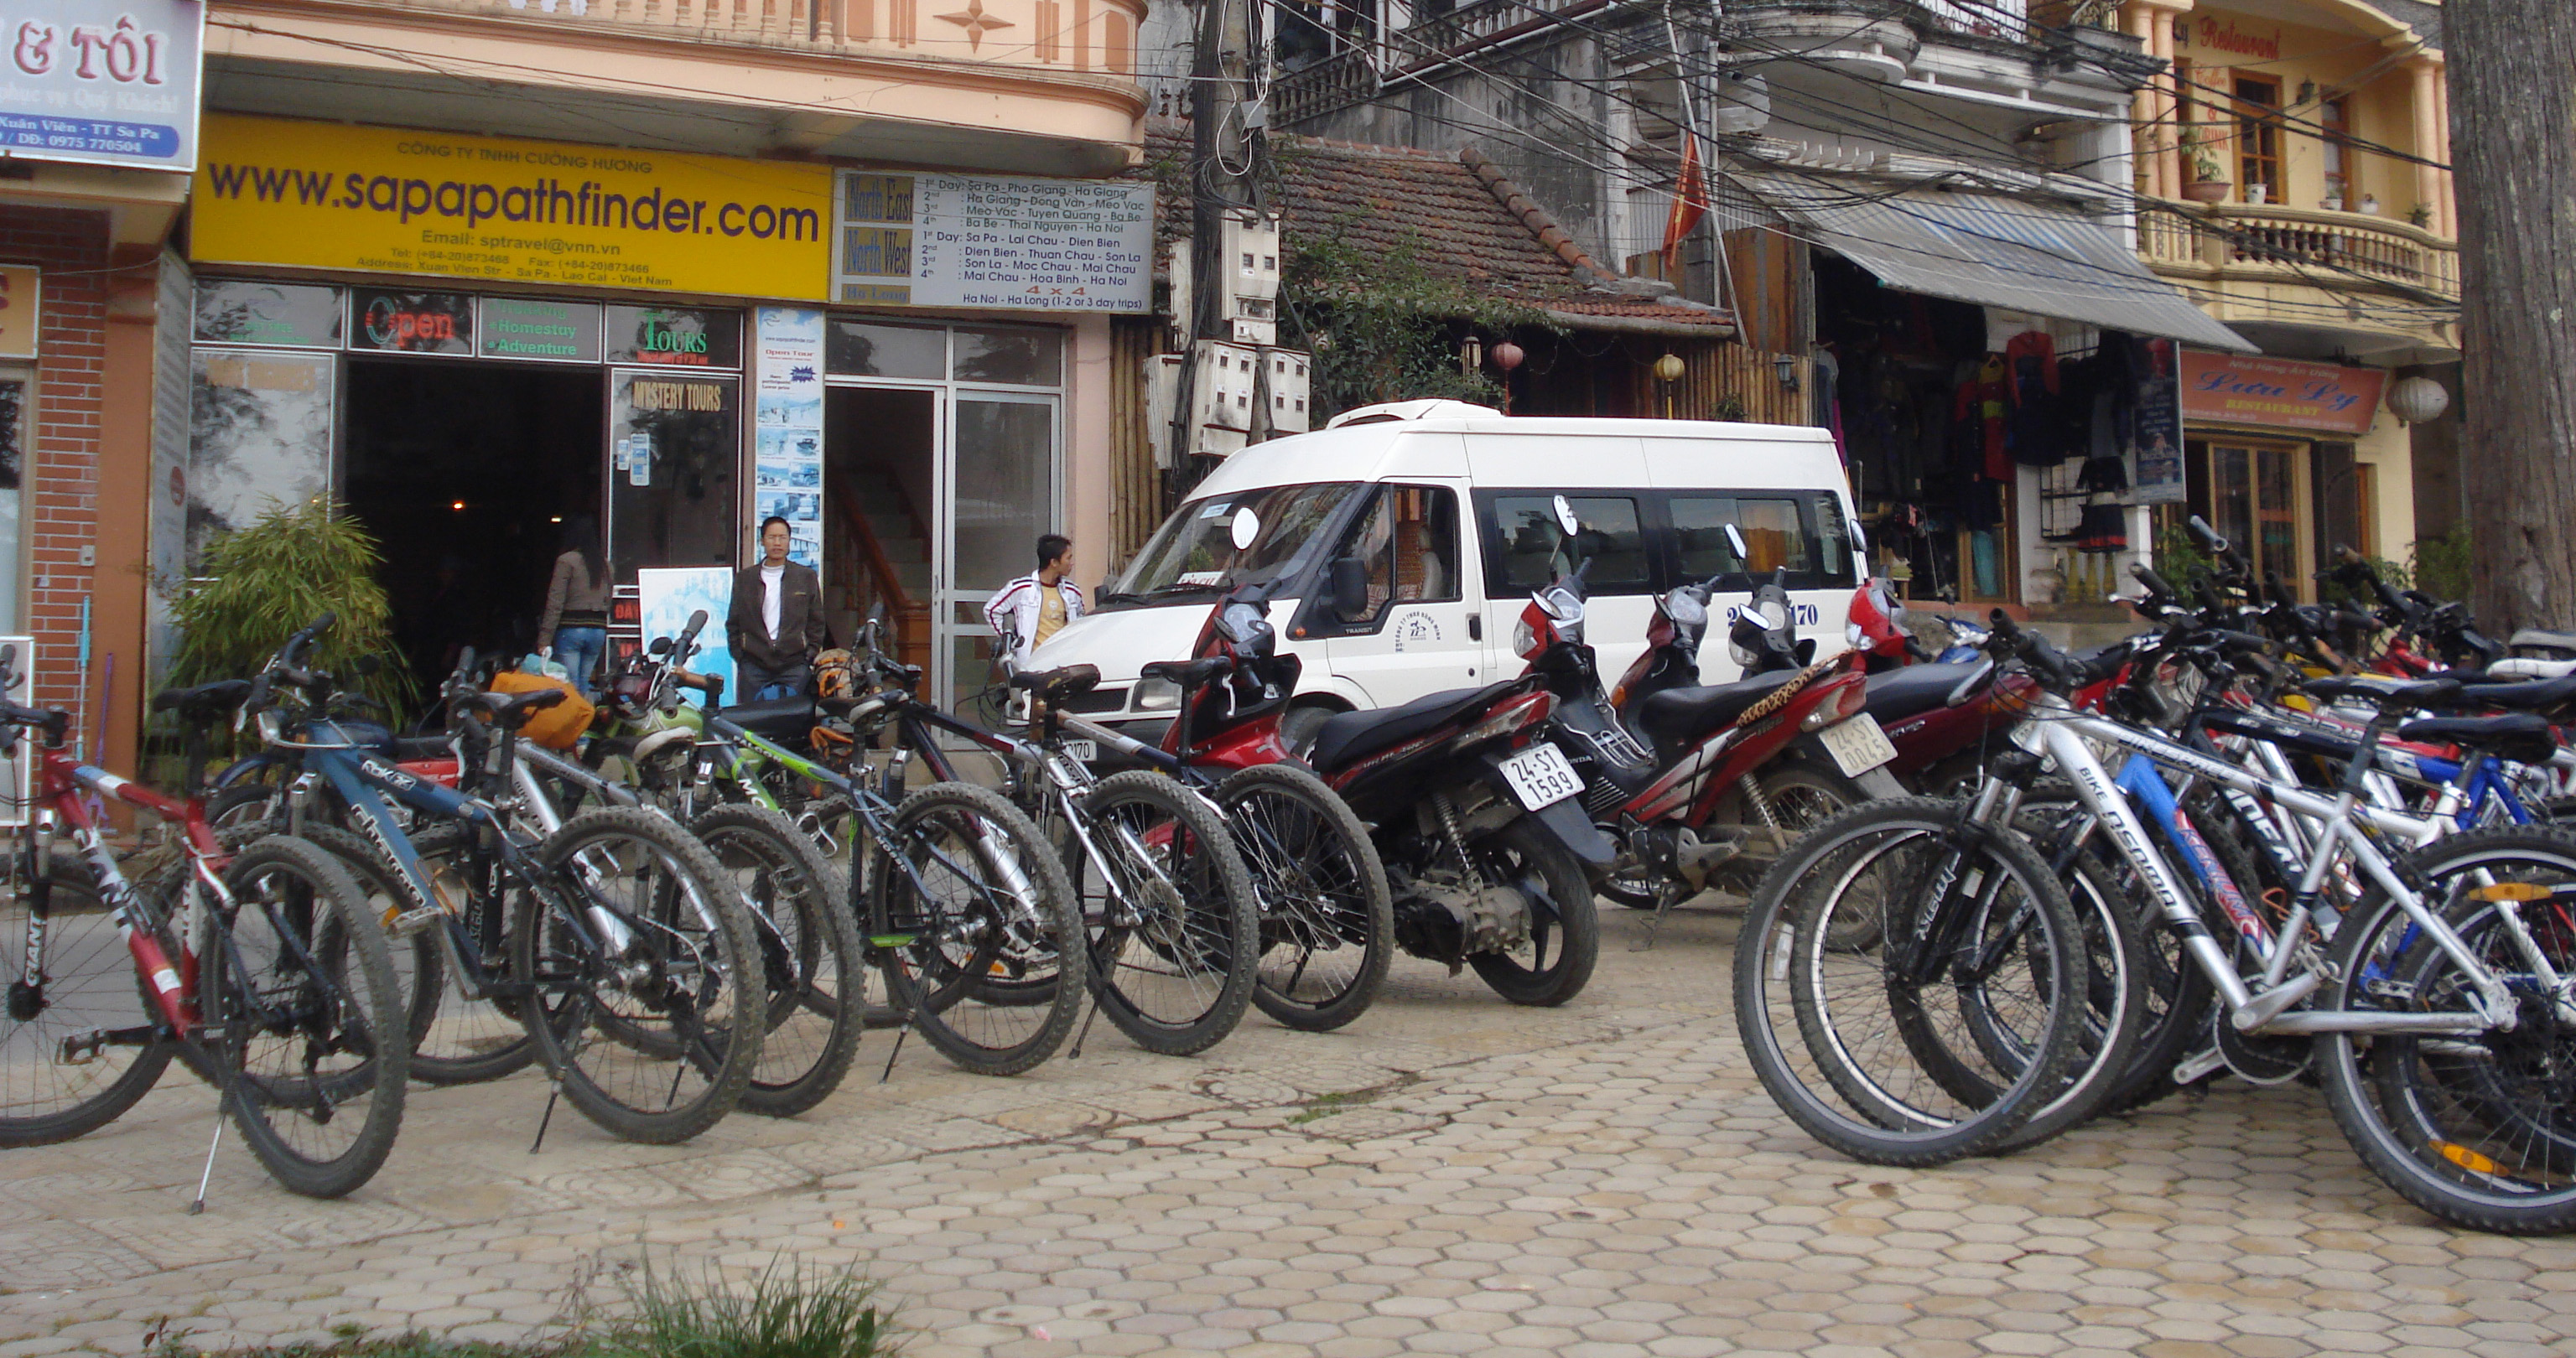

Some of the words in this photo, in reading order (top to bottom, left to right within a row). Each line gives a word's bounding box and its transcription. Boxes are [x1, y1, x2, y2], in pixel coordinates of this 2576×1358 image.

[2199, 16, 2281, 60] Restaurant
[14, 22, 54, 75] &
[72, 15, 163, 85] TÔI
[91, 123, 112, 136] TT
[117, 126, 136, 138] Sa
[140, 127, 160, 140] Pa
[49, 135, 84, 148] 0975
[969, 180, 982, 191] Sa
[985, 182, 1000, 192] Pa
[1008, 183, 1029, 194] Pho
[1075, 185, 1090, 195] Ha
[208, 163, 818, 242] www.sapapathfinder.com
[886, 177, 913, 221] East
[967, 193, 982, 203] Ha
[1031, 196, 1060, 209] Dong
[1063, 198, 1085, 208] Van
[1095, 200, 1120, 210] Meo
[1124, 201, 1145, 210] Vac
[967, 205, 992, 215] Meo
[995, 207, 1017, 216] Vac
[1028, 208, 1059, 220] Tuyen
[1062, 210, 1100, 222] Quang
[1110, 211, 1124, 221] Ba
[966, 218, 980, 227] Ba
[984, 218, 998, 228] Be
[1035, 221, 1078, 233] Nguyen
[1087, 222, 1102, 232] Ha
[422, 229, 475, 246] Email:
[966, 232, 979, 242] Sa
[984, 233, 997, 243] Pa
[1027, 236, 1057, 245] Chau
[1097, 238, 1120, 247] Bien
[885, 231, 912, 275] West
[994, 247, 1017, 257] Bien
[1029, 249, 1062, 259] Thuan
[1064, 251, 1094, 261] Chau
[1105, 252, 1125, 262] Son
[1129, 253, 1140, 262] La
[357, 257, 413, 269] Address:
[517, 267, 532, 277] Sa
[563, 271, 584, 280] Lao
[646, 276, 672, 286] Nam
[965, 258, 985, 268] Son
[989, 259, 1002, 269] La
[1013, 261, 1038, 271] Moc
[1041, 262, 1072, 272] Chau
[1106, 264, 1136, 274] Chau
[988, 272, 1019, 282] Chau
[1030, 273, 1053, 283] Hoa
[1090, 275, 1105, 285] Ha
[1026, 285, 1041, 294] 4
[1072, 287, 1086, 296] 4
[963, 293, 978, 303] Ha
[1007, 295, 1021, 304] Ha
[1025, 295, 1048, 308] Long
[1087, 298, 1093, 307] 3
[1096, 298, 1115, 309] day
[1118, 298, 1142, 309] trips)
[365, 296, 454, 348] Open
[497, 319, 578, 339] Homestay
[497, 339, 577, 355] Adventure
[632, 381, 684, 410] MYSTERY
[686, 384, 721, 412] TOURS
[2225, 399, 2320, 417] RESTAURANT
[1567, 755, 1593, 765] ONDA
[1845, 739, 1888, 770] 0045
[1527, 771, 1574, 803] 1599
[2079, 767, 2108, 801] BIKE
[25, 910, 48, 987] GIANT
